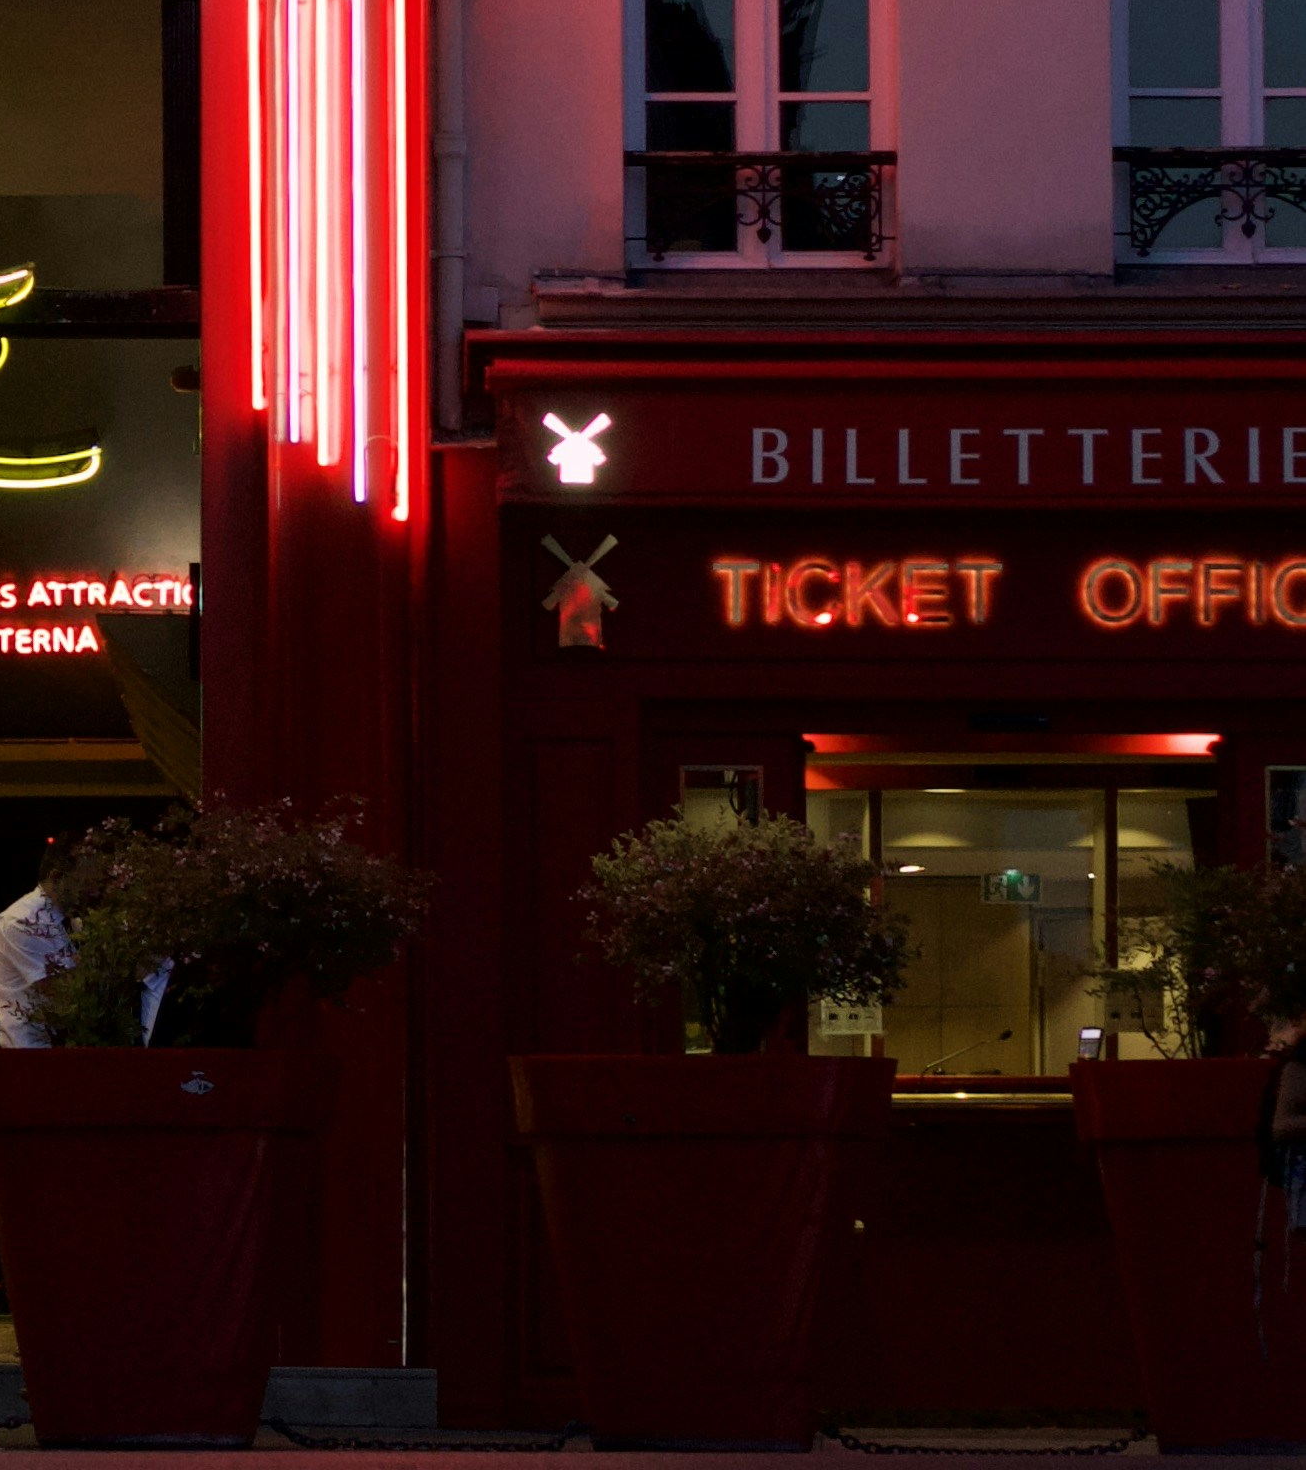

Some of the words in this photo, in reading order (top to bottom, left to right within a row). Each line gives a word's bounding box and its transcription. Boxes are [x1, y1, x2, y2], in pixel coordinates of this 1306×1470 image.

[751, 427, 1306, 485] BILLETTERIE
[712, 559, 1004, 627] TICKET
[1080, 557, 1306, 627] OFFIC
